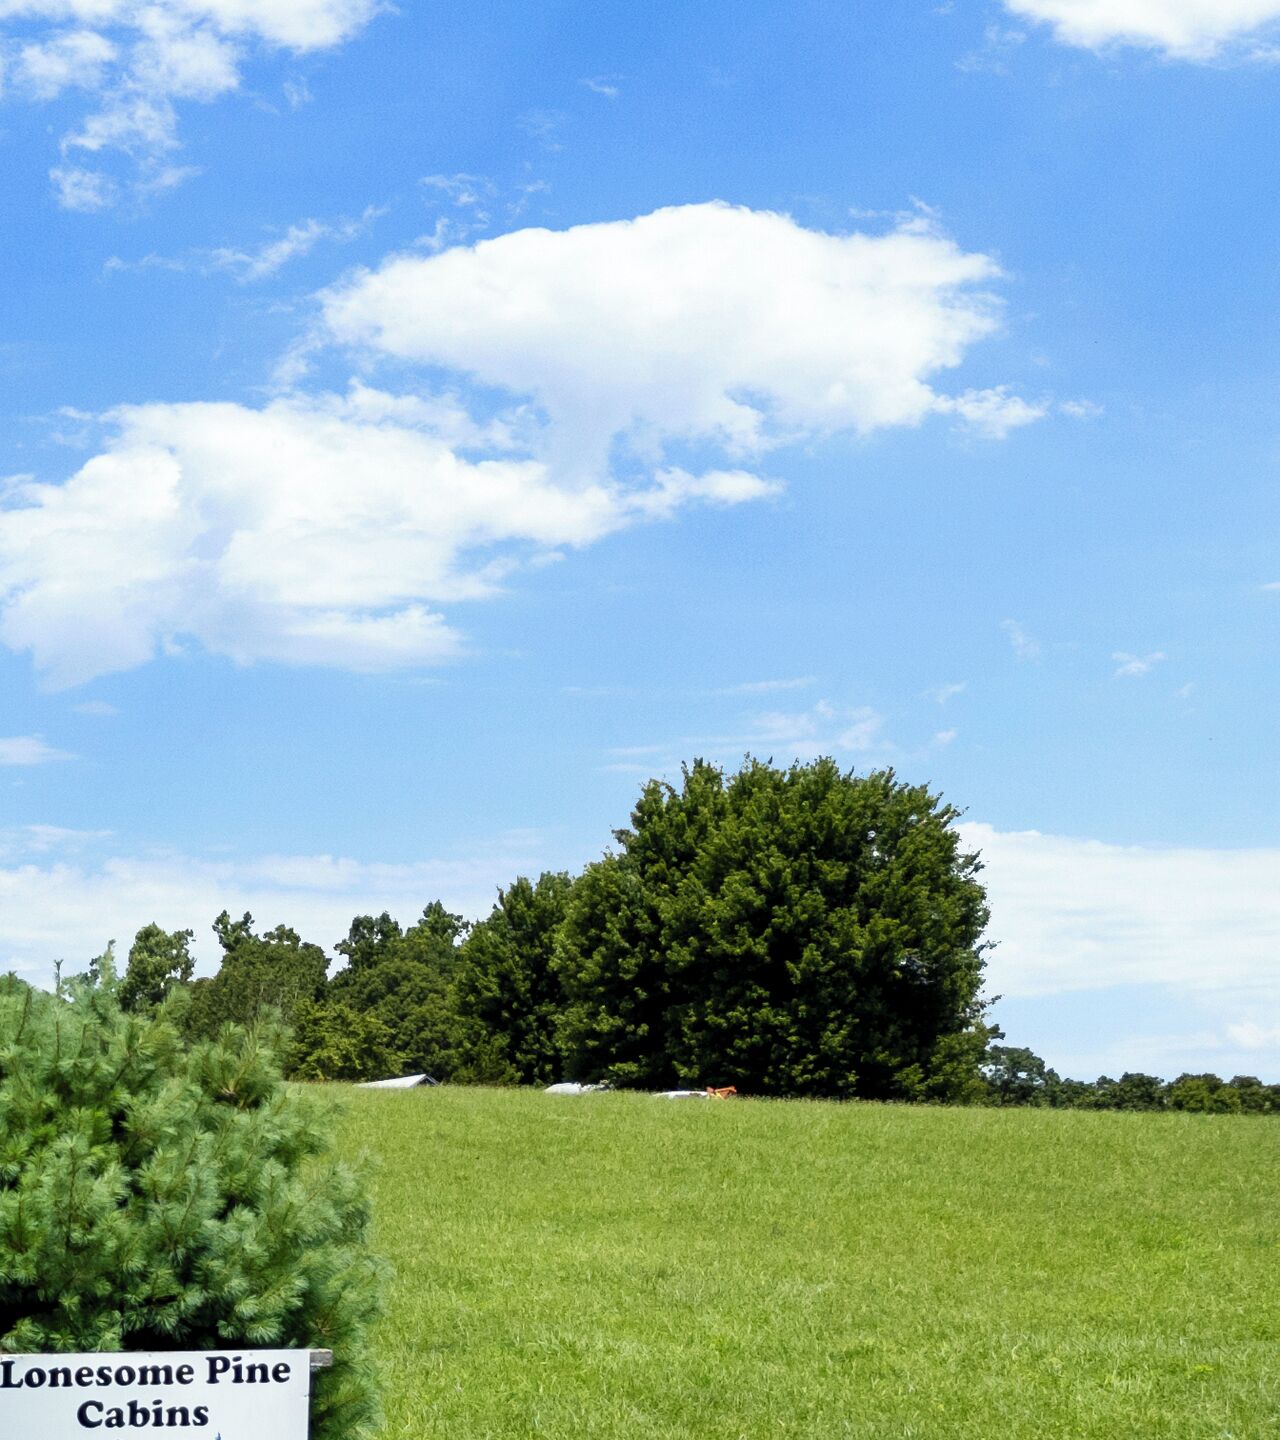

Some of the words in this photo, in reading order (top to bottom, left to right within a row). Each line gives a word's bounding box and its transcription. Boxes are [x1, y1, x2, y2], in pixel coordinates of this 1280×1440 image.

[0, 1359, 195, 1389] Lonesome
[206, 1355, 292, 1385] Pine
[76, 1399, 210, 1429] Cabins
